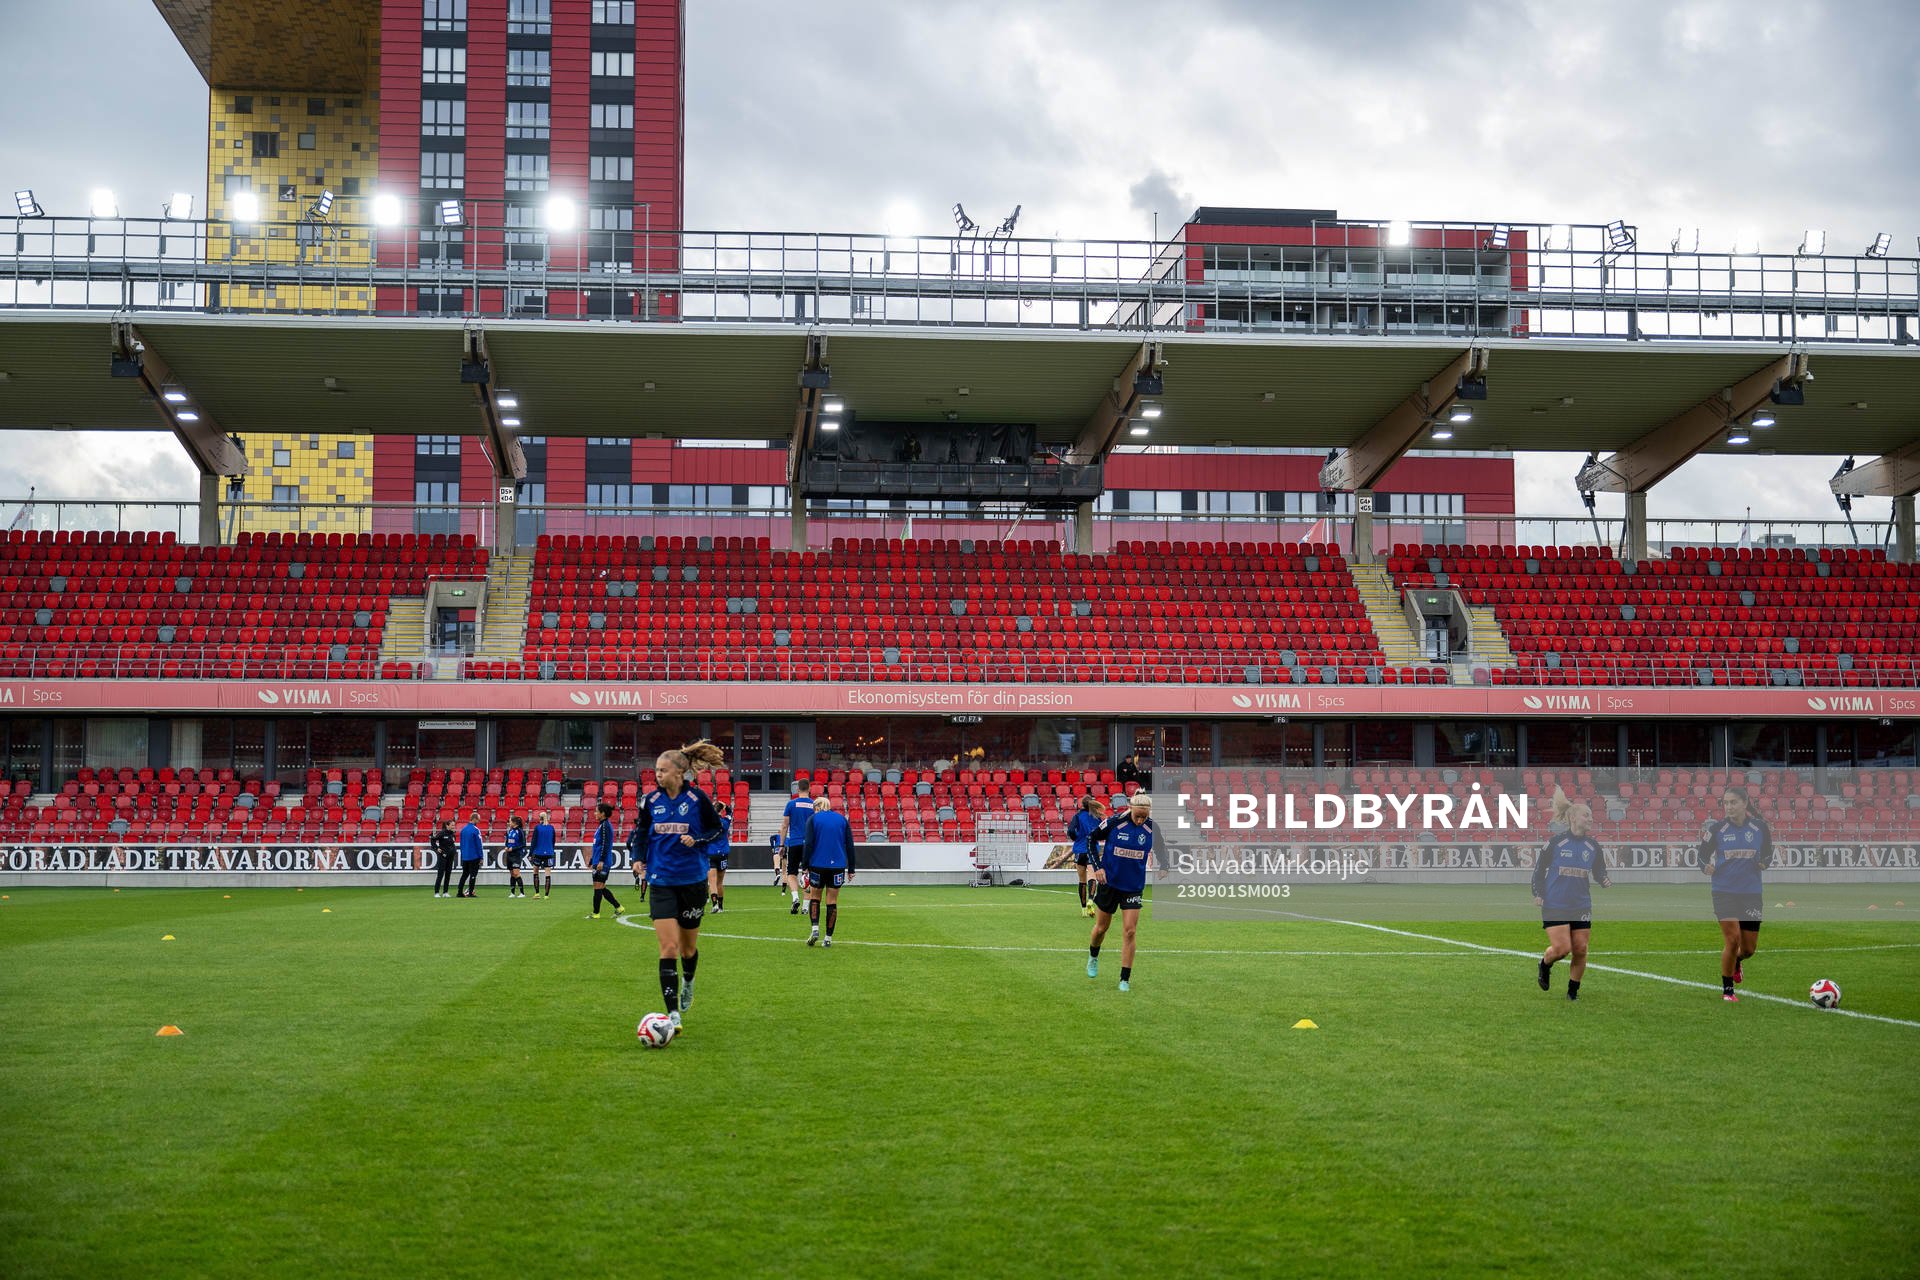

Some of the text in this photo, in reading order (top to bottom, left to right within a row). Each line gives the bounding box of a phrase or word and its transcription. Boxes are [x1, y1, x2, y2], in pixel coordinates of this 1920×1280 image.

[32, 689, 62, 703] Spcs
[283, 689, 379, 705] VISMA Spcs
[594, 690, 688, 706] VISMA Spcs
[848, 690, 1073, 708] Ekonomisystem för din passion
[1255, 693, 1345, 709] VISMA Spcs
[1546, 695, 1634, 710] VISMA Spcs
[1829, 696, 1916, 711] VISMA Spcs
[166, 846, 350, 870] TRÄVARORNA
[357, 849, 413, 870] OCH
[1381, 843, 1514, 868] HÅLLBARA
[1632, 848, 1664, 868] DE
